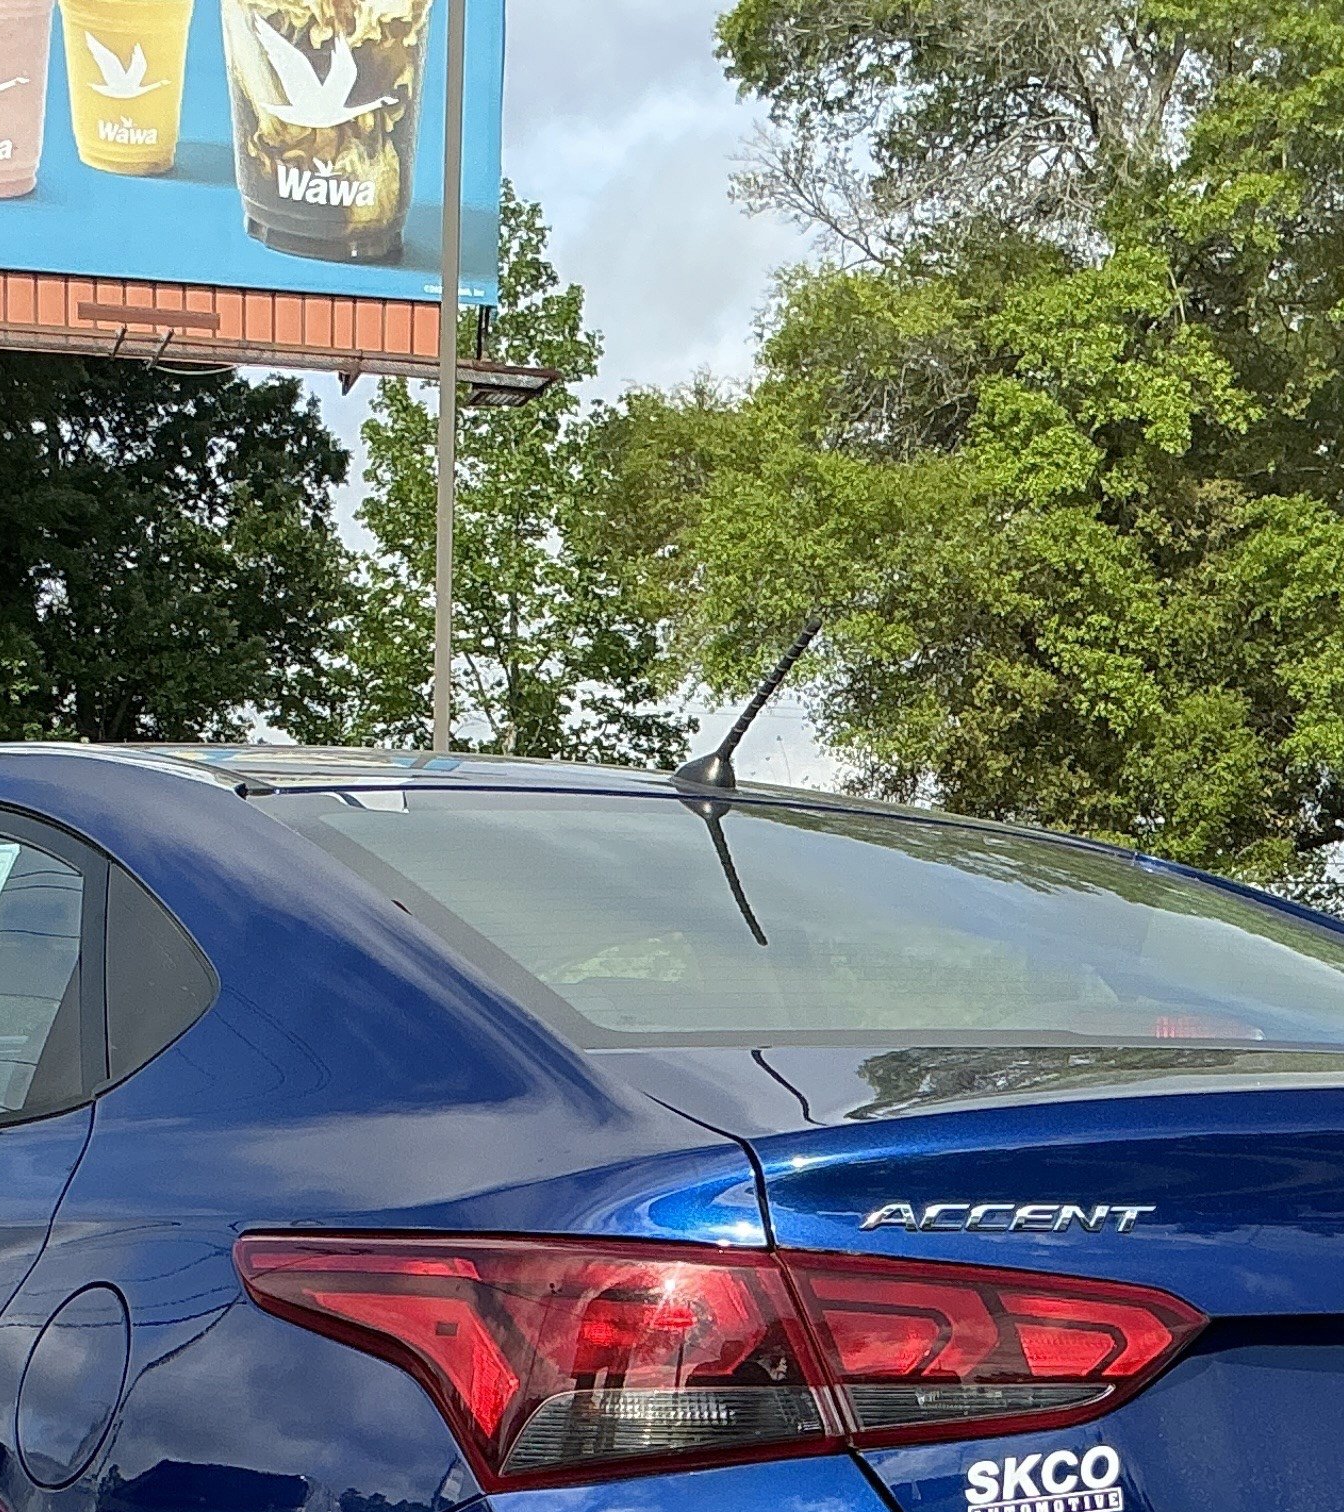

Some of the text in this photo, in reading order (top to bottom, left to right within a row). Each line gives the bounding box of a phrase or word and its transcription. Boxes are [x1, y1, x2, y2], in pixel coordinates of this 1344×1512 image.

[98, 117, 158, 146] Wawa
[276, 163, 376, 207] Wawa
[858, 1202, 1157, 1233] ACCENT
[964, 1445, 1121, 1505] SKCO
